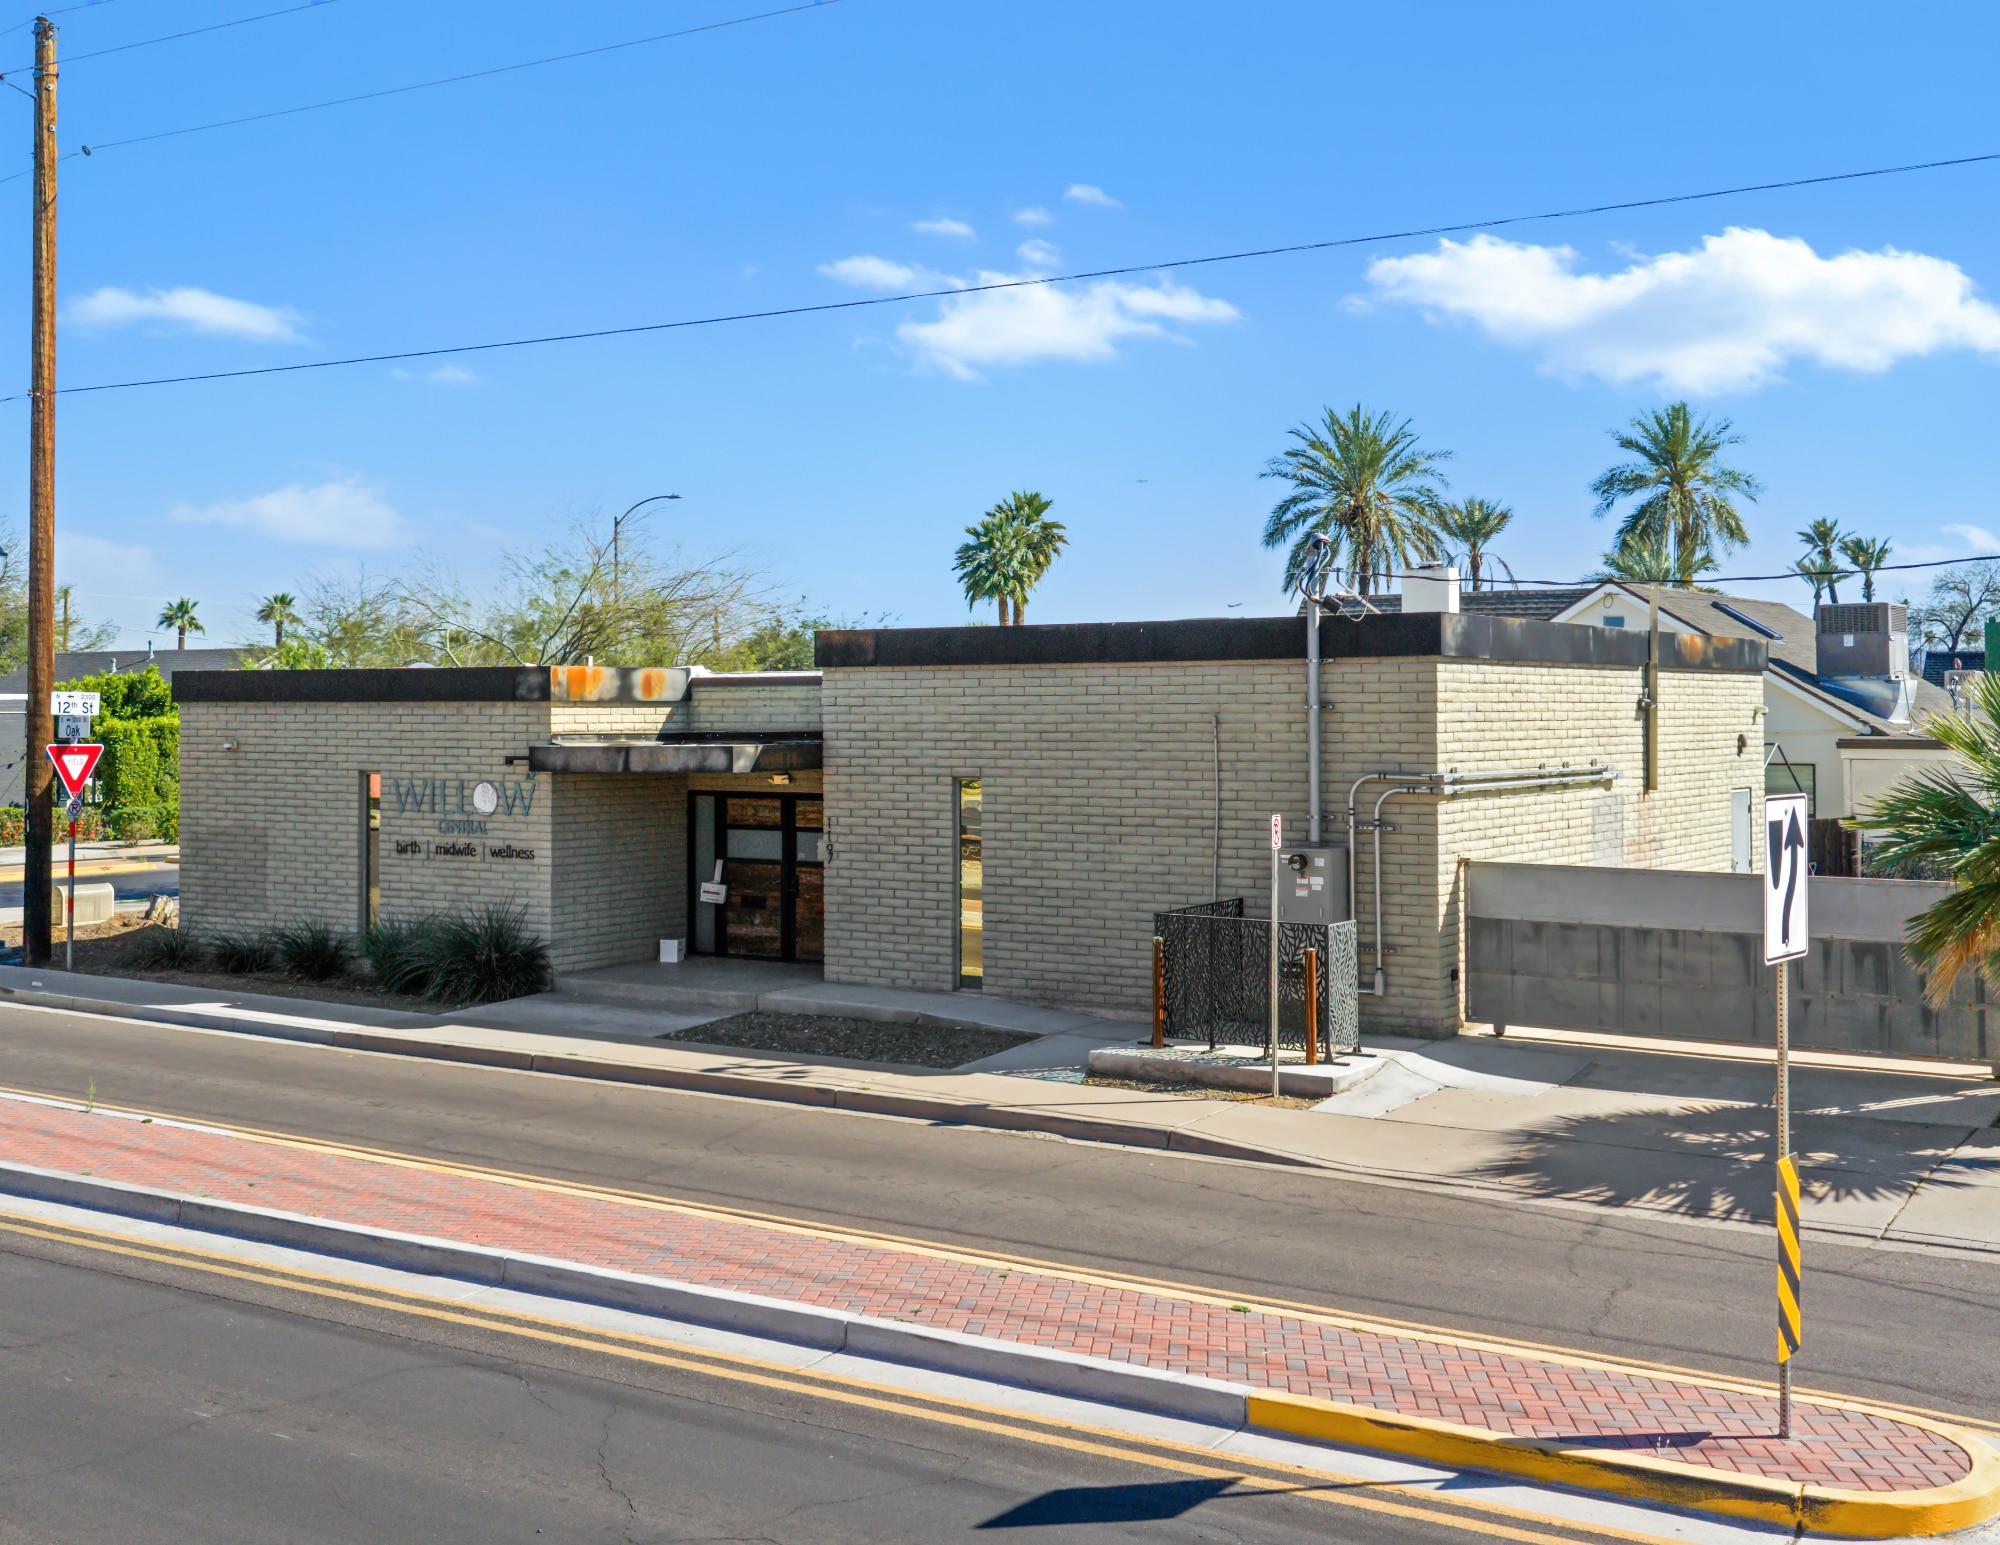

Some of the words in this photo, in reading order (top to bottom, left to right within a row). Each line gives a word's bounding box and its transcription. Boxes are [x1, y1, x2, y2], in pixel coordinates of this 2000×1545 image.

[58, 701, 78, 714] 12th
[82, 701, 94, 714] St
[65, 724, 81, 737] Oak
[67, 758, 84, 766] YIELD
[393, 779, 537, 816] WILLOW
[436, 820, 489, 835] CENTRAL
[396, 839, 421, 855] birth
[435, 841, 477, 857] midwife
[489, 844, 535, 860] wellness
